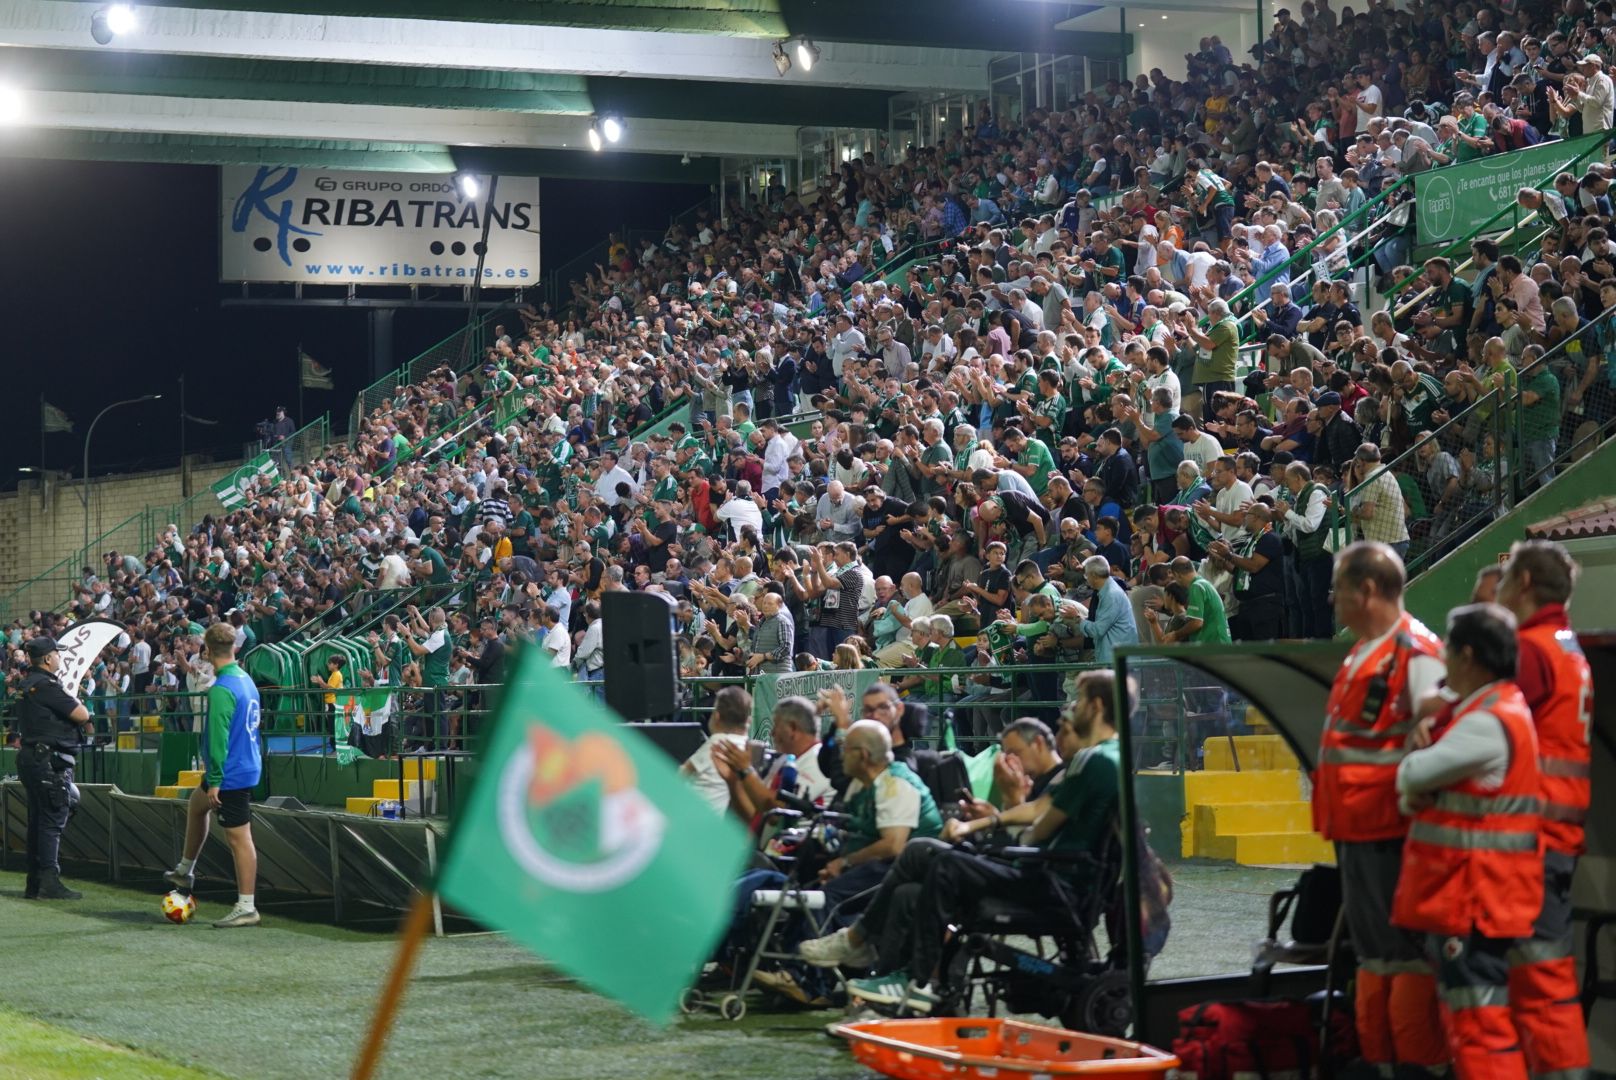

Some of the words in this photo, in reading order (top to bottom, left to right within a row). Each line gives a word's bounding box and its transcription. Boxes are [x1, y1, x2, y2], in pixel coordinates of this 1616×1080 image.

[1469, 174, 1496, 189] encanta
[1497, 171, 1510, 184] que
[1511, 168, 1522, 180] los
[1523, 163, 1546, 180] planes
[343, 181, 402, 192] GRUPO
[409, 180, 453, 193] ORDÓ
[1498, 185, 1511, 199] 681
[302, 198, 531, 230] RIBATRANS
[305, 264, 529, 278] www.ribatrans.es
[57, 625, 92, 679] RANS
